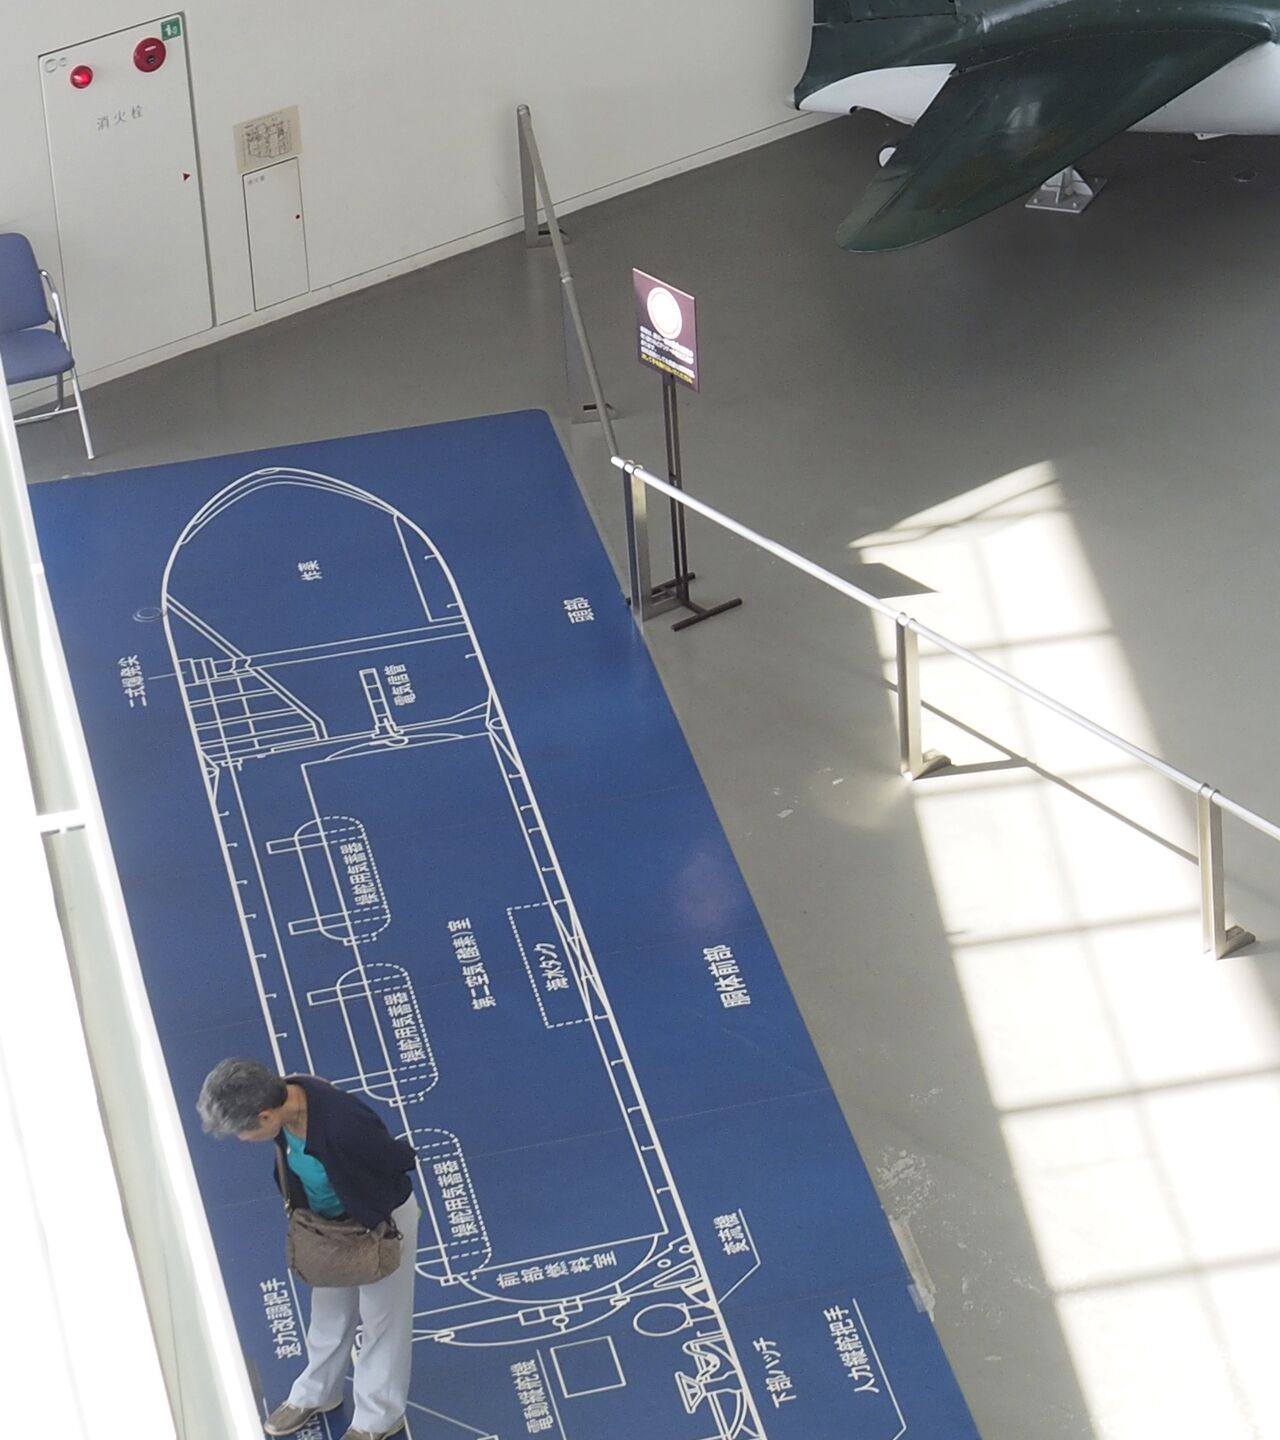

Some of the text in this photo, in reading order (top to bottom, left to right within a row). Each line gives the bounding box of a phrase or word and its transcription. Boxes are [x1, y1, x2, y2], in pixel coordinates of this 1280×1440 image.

[96, 105, 144, 131] 消火栓
[298, 560, 322, 581] 炸薬
[563, 596, 594, 624] 頭部
[385, 663, 416, 706] 電気信管
[703, 945, 751, 1009] 胴体前部
[712, 1213, 748, 1255] 変流機
[752, 1338, 797, 1407] 下部ハッチ
